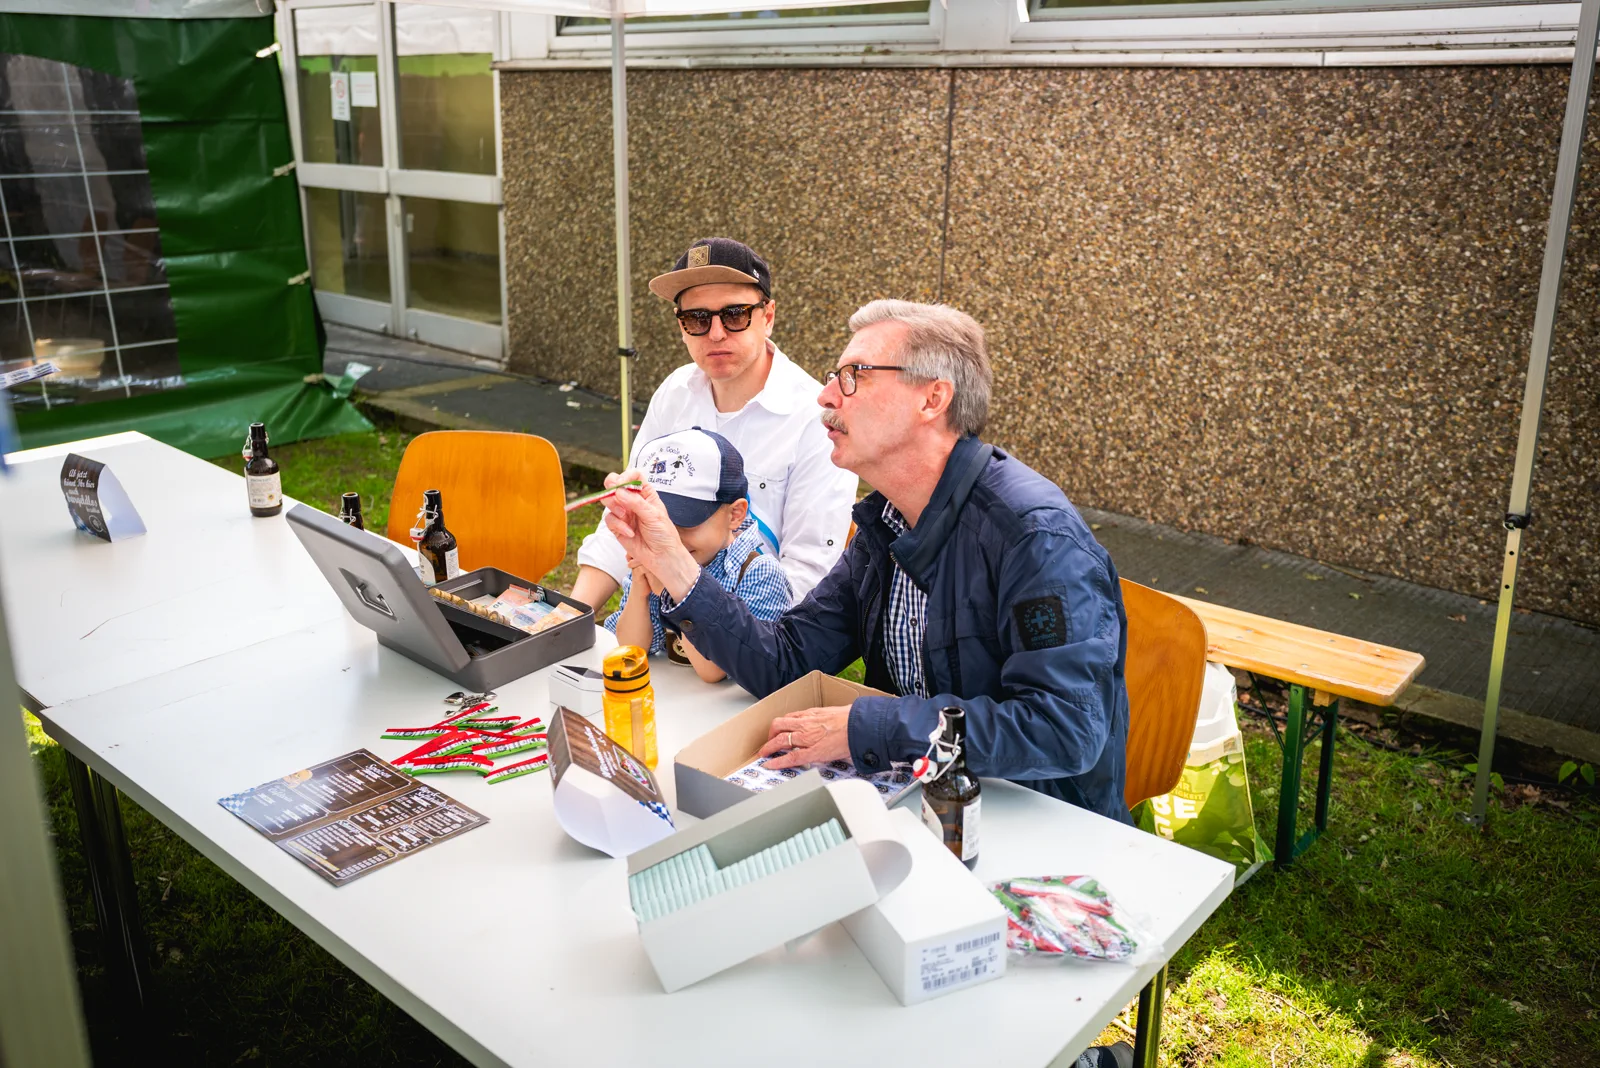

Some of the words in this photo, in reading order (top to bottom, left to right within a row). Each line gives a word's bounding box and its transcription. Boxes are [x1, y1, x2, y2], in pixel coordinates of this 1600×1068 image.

[69, 469, 76, 478] Ab
[77, 470, 88, 479] jetzt
[85, 480, 95, 489] hier
